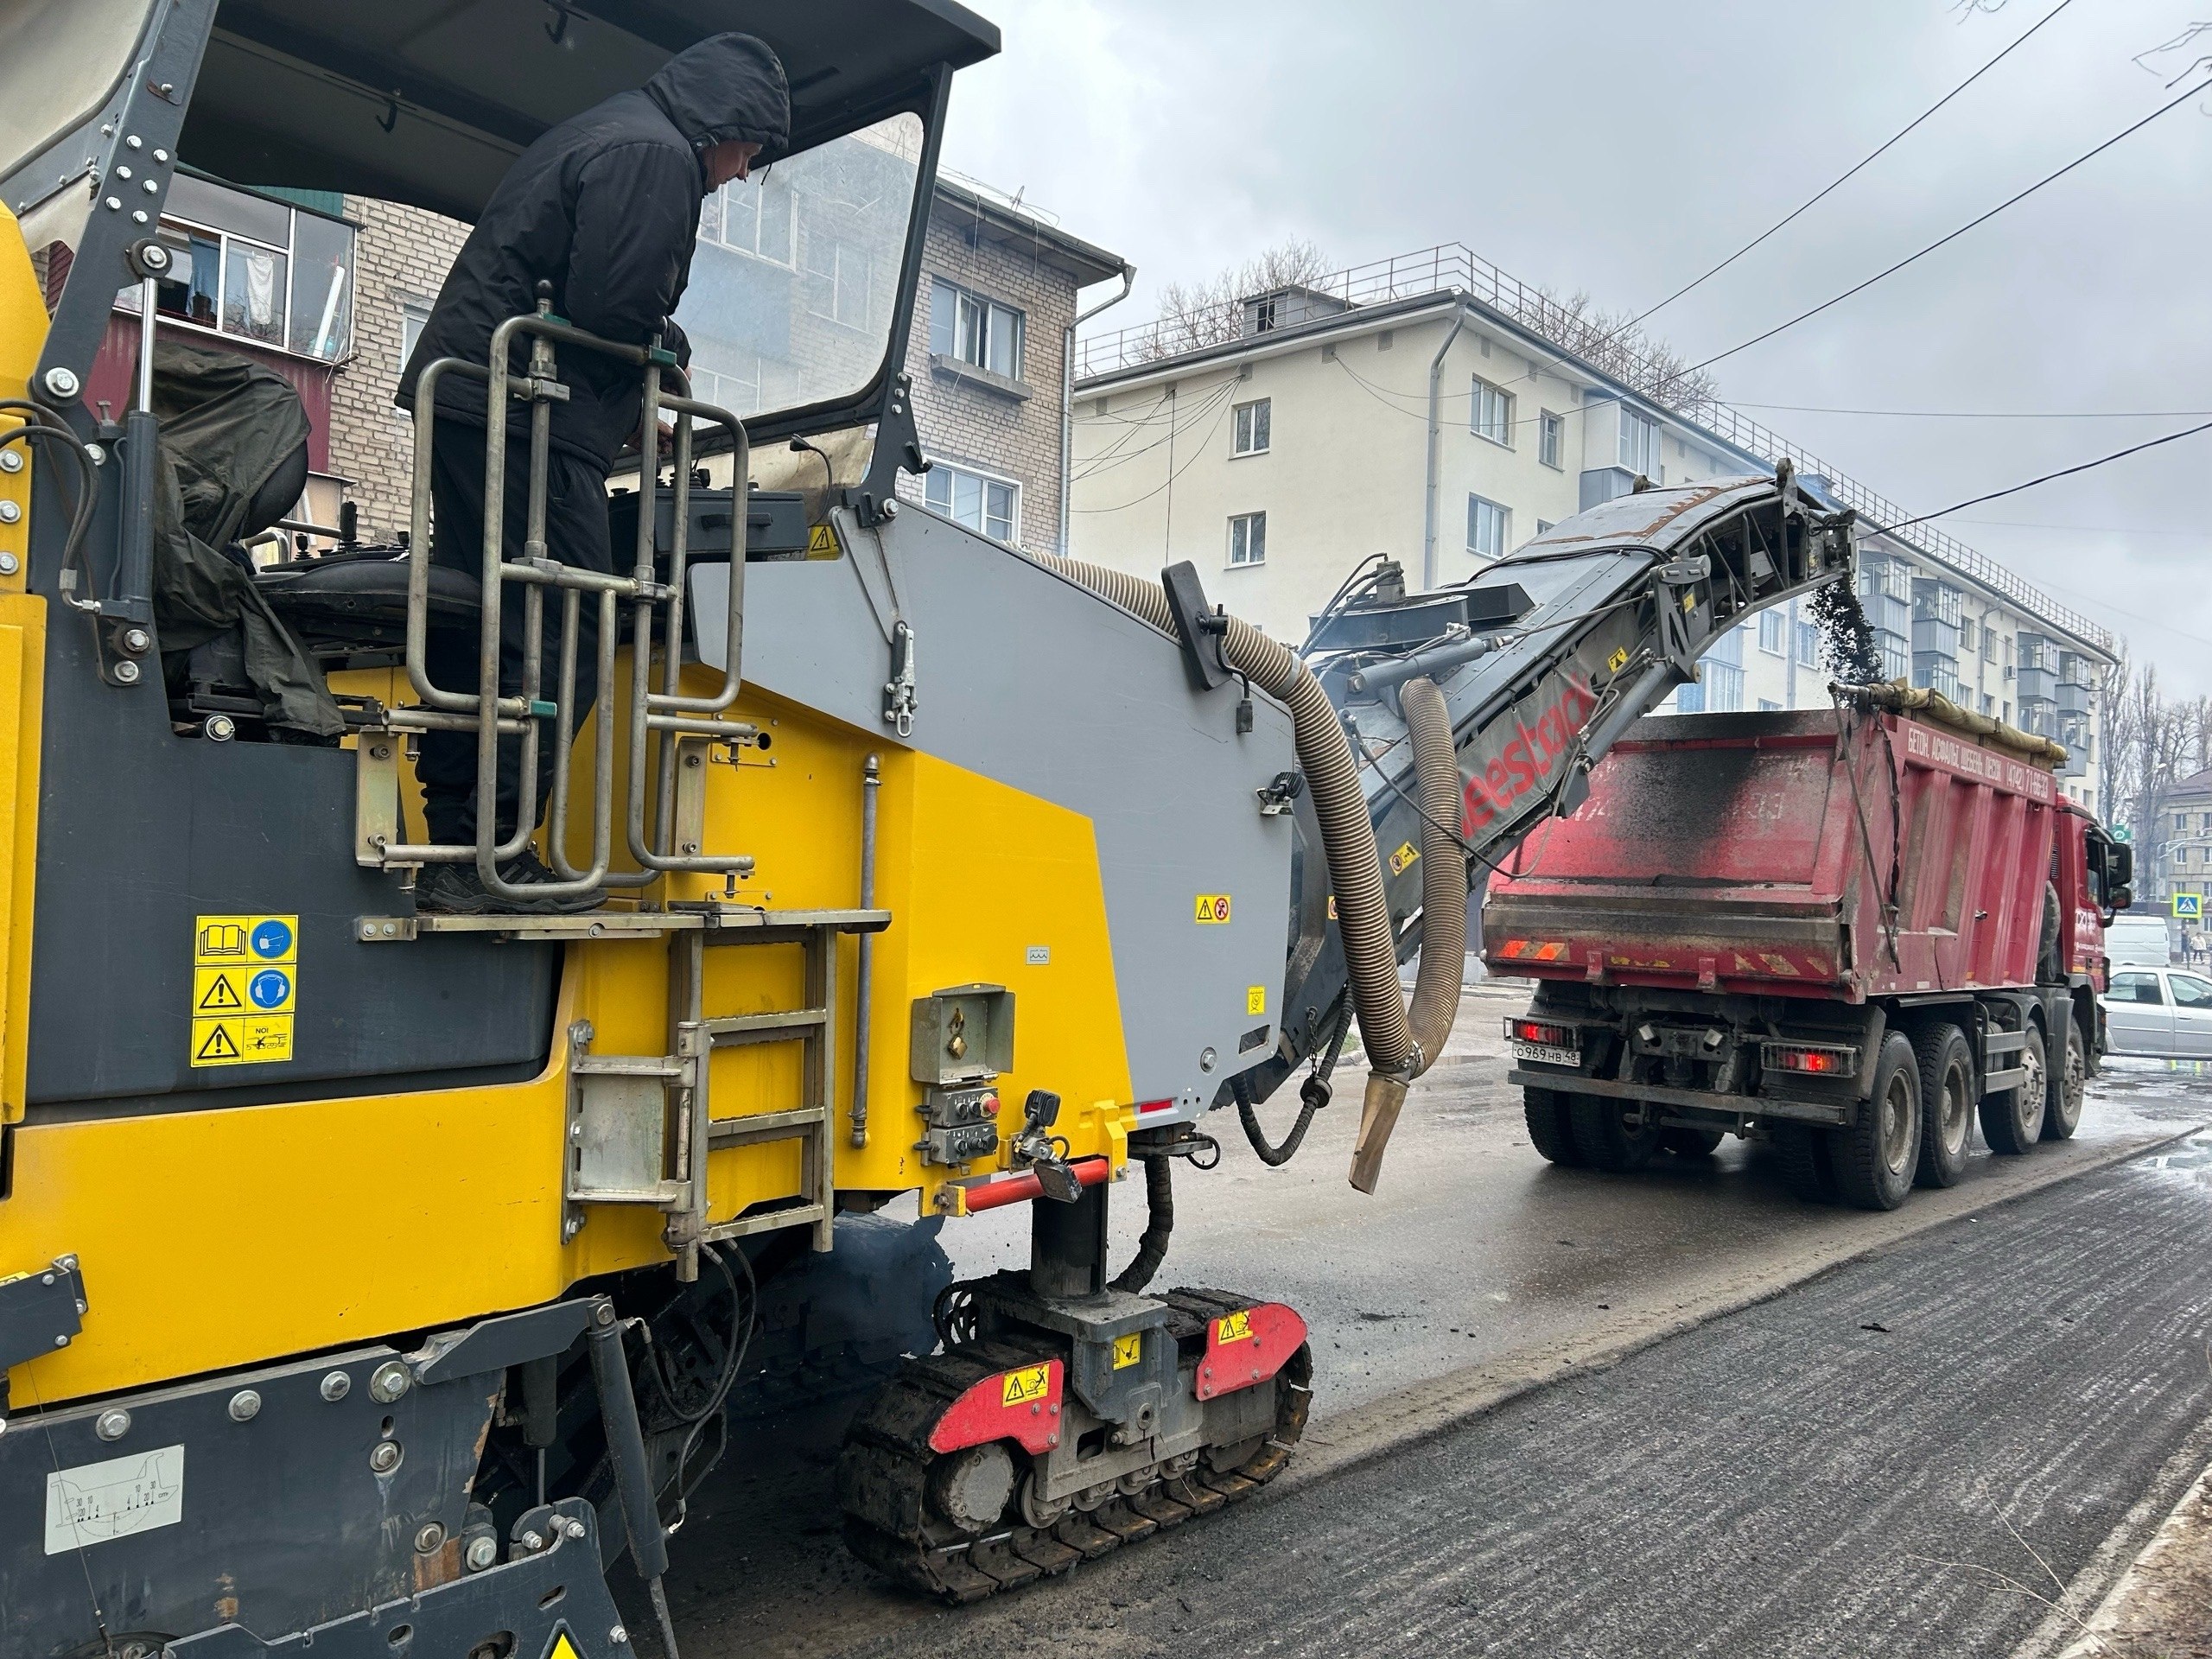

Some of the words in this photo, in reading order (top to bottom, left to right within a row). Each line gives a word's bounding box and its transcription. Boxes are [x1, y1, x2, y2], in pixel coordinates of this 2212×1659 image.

[1460, 671, 1598, 840] eestack
[1908, 728, 1929, 759] БЕТОН,
[2006, 762, 2024, 791] (4742)
[1565, 1052, 1576, 1062] 48
[150, 1480, 156, 1490] 30
[77, 1497, 82, 1506] 30
[87, 1495, 92, 1504] 10
[144, 1492, 149, 1502] 20
[79, 1508, 86, 1516] 20
